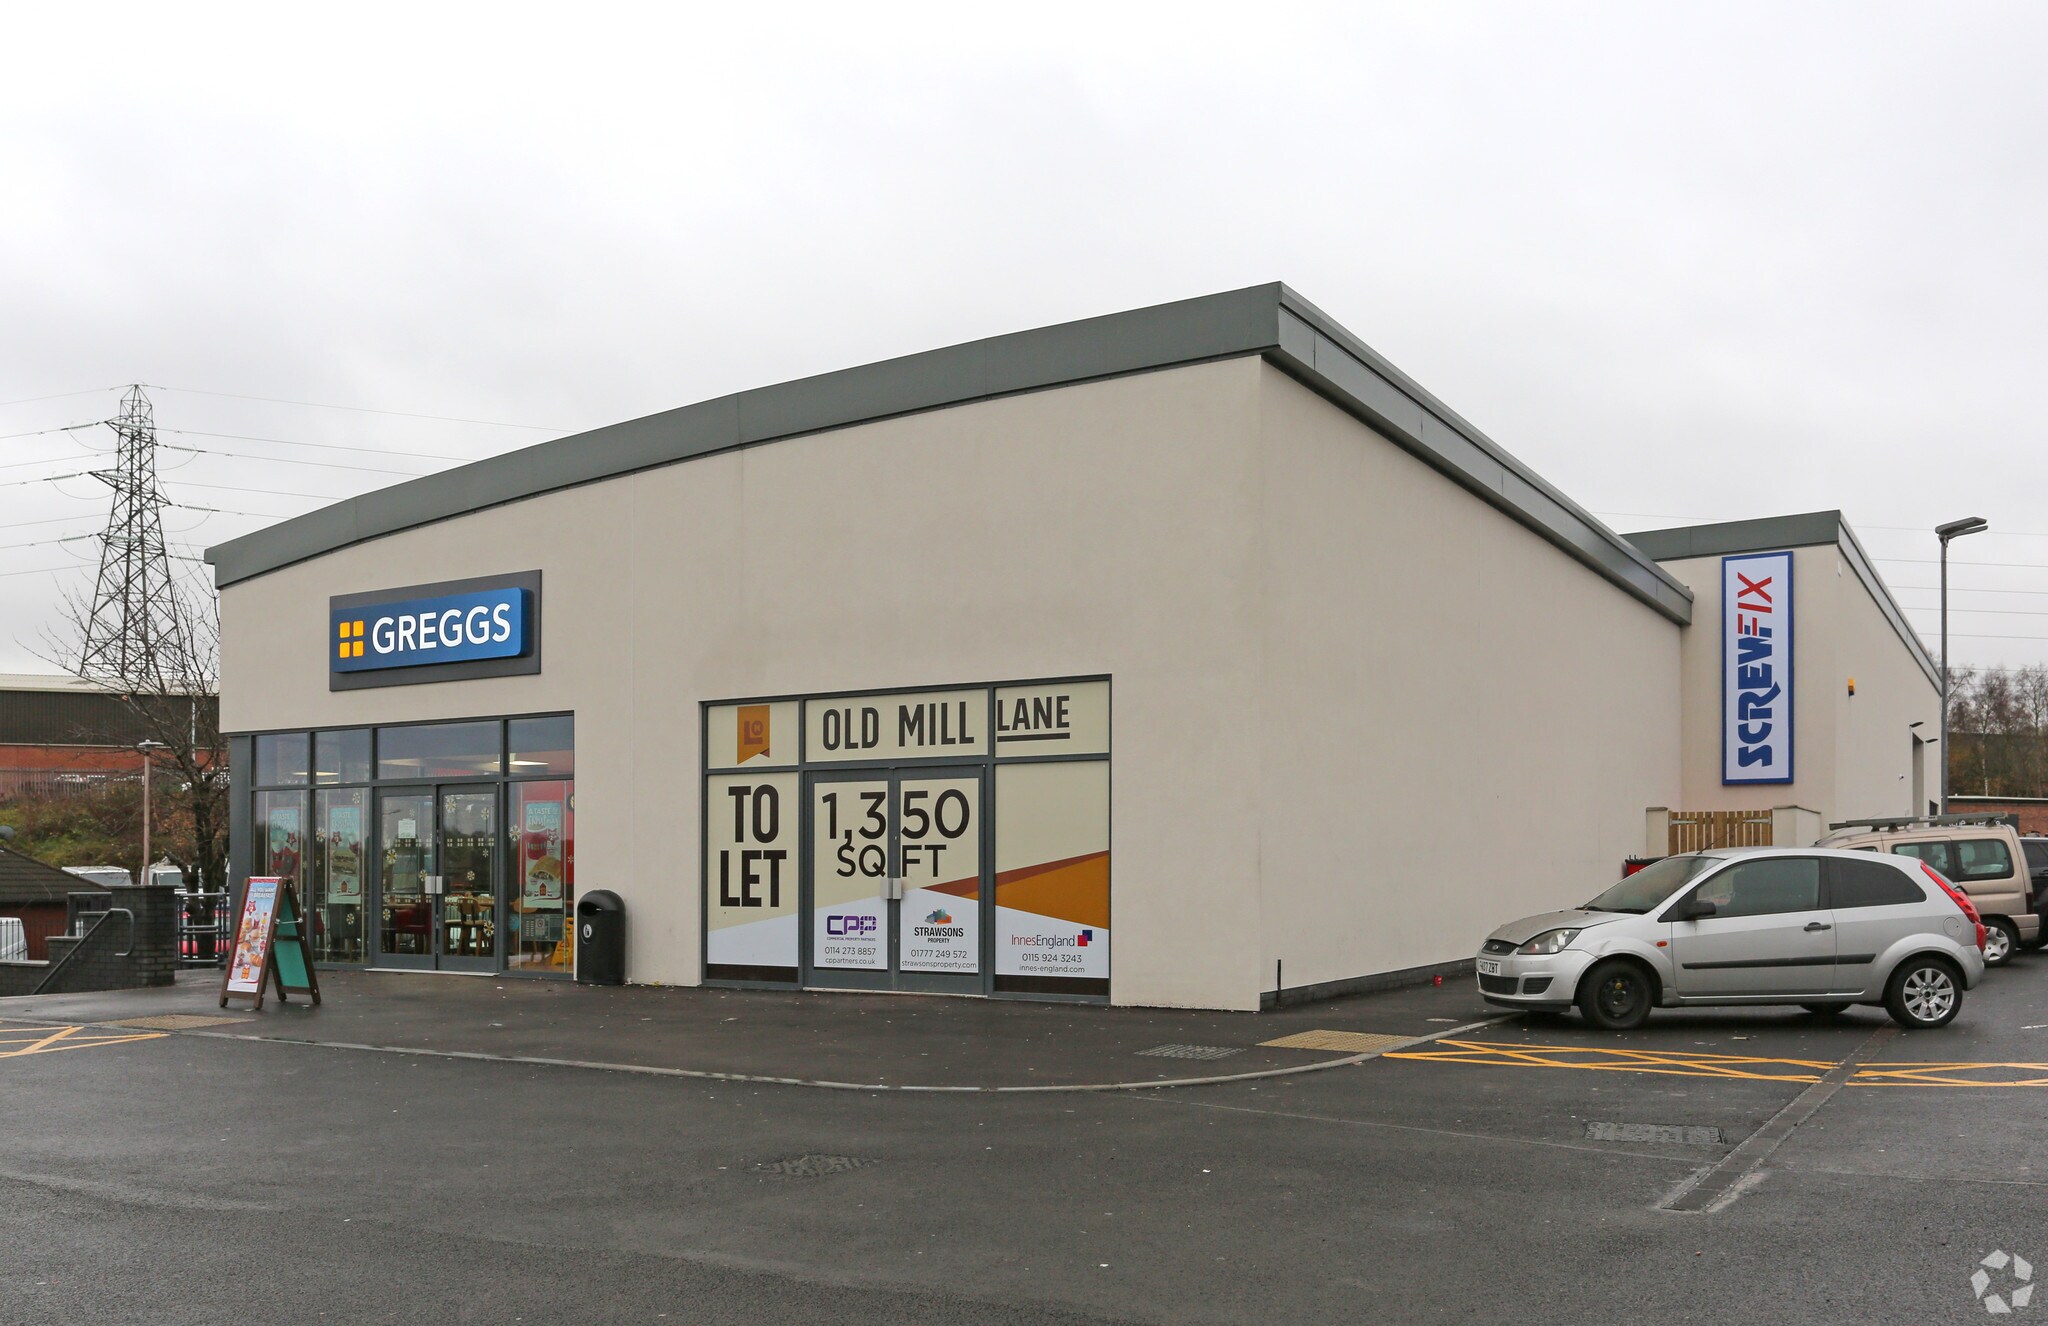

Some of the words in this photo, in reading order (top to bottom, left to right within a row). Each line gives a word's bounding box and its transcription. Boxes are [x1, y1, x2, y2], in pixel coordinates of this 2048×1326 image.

[372, 603, 511, 654] GREGGS
[1738, 572, 1781, 768] SCREWFIX
[823, 707, 879, 751] OLD
[898, 701, 975, 747] MILL
[997, 695, 1070, 731] LANE
[728, 784, 779, 843] TO
[822, 788, 970, 846] 1,350
[836, 844, 886, 877] SQ
[902, 844, 947, 877] FT
[720, 850, 787, 907] LET
[914, 926, 964, 938] STRAWSONS
[1011, 934, 1076, 950] InnesEngland
[824, 946, 840, 955] 0114
[842, 946, 856, 955] 273
[857, 947, 876, 956] 8857
[910, 948, 934, 958] 01777
[935, 949, 951, 959] 249
[952, 950, 968, 959] 572
[1021, 952, 1040, 962] 0115
[1041, 953, 1058, 962] 924
[1060, 954, 1082, 963] 3243
[824, 957, 876, 965] cppartners.co.uk
[901, 960, 977, 970] strawsonsproperty.com
[1018, 964, 1085, 974] innes-england.com
